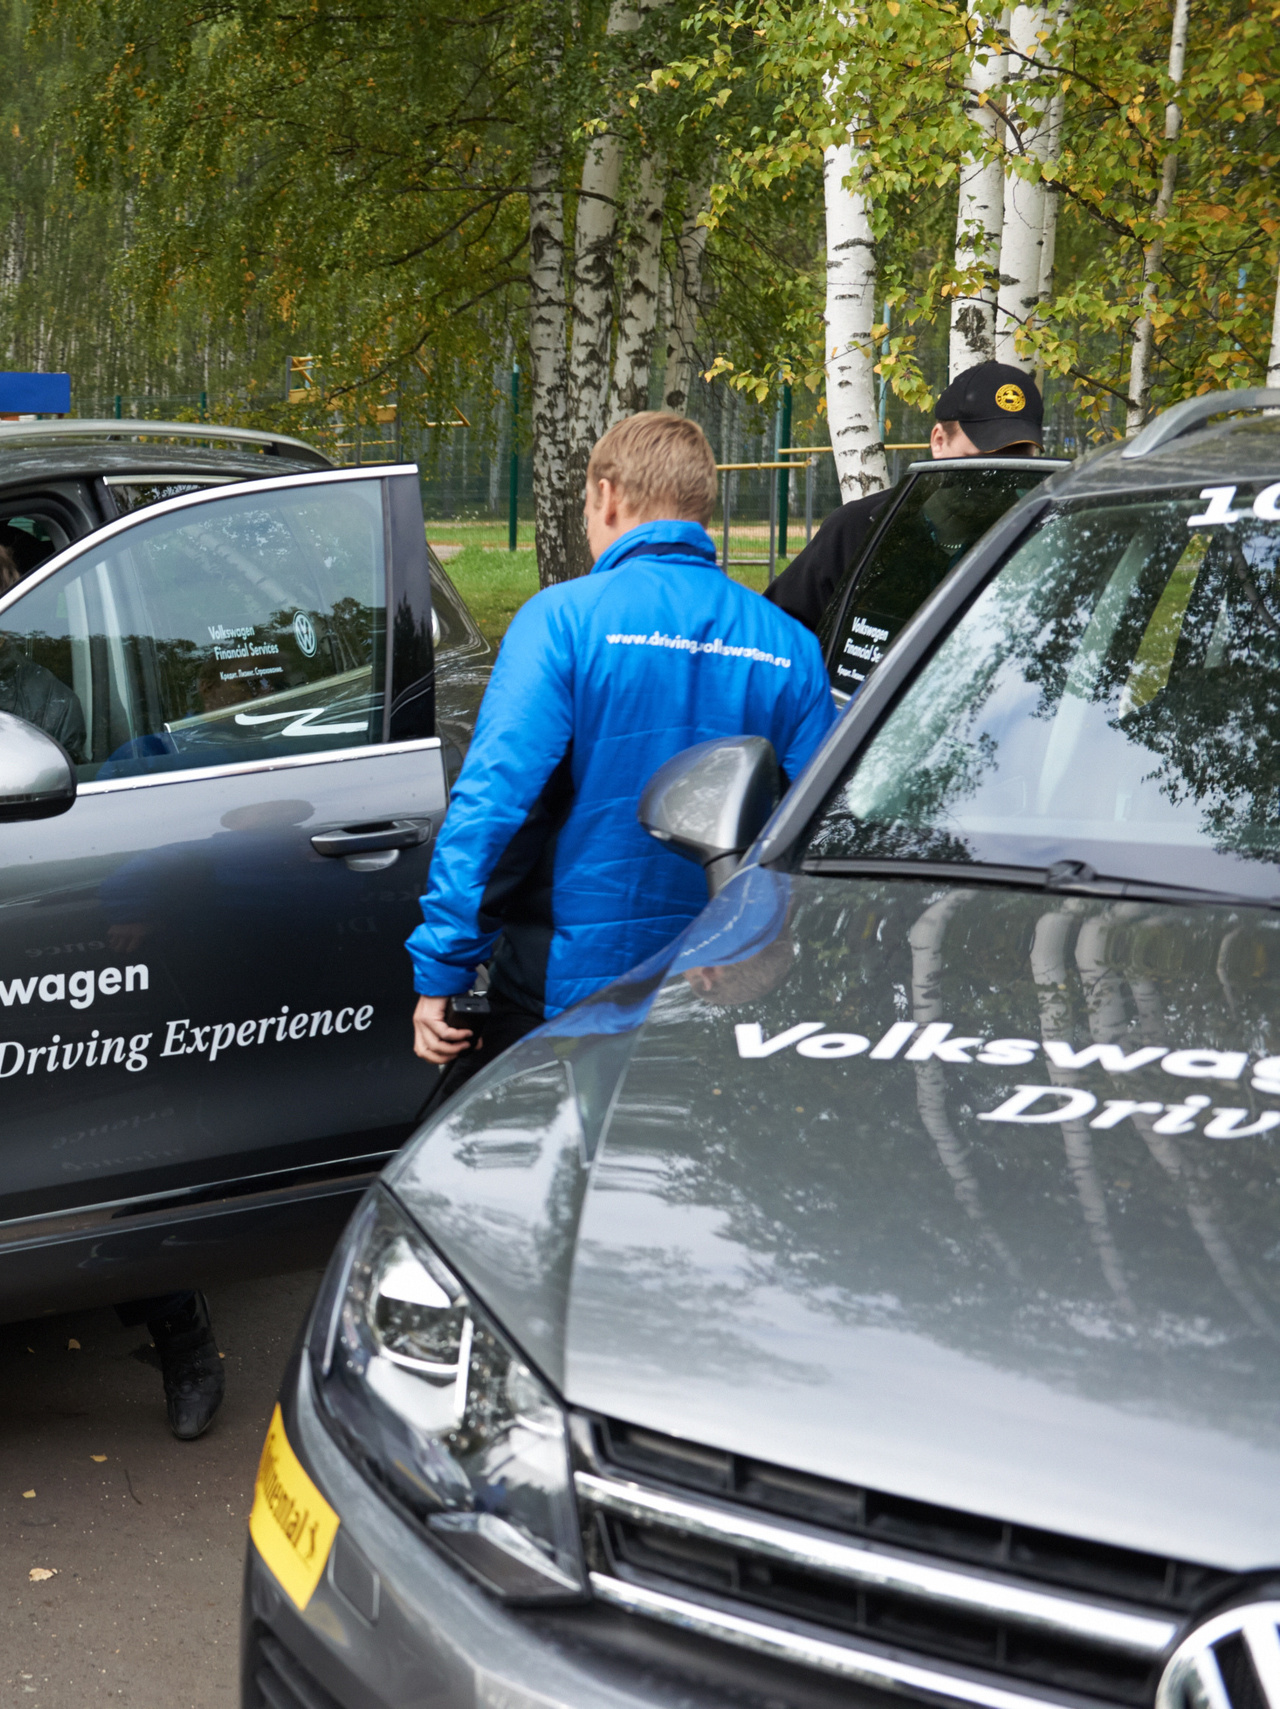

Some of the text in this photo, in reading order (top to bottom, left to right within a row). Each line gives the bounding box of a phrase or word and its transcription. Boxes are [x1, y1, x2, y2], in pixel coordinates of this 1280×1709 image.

[208, 624, 255, 640] Volkswagen
[851, 616, 889, 643] Volkswagen
[214, 642, 279, 660] Financial Services
[843, 638, 874, 660] Financial
[159, 1004, 374, 1061] Experience
